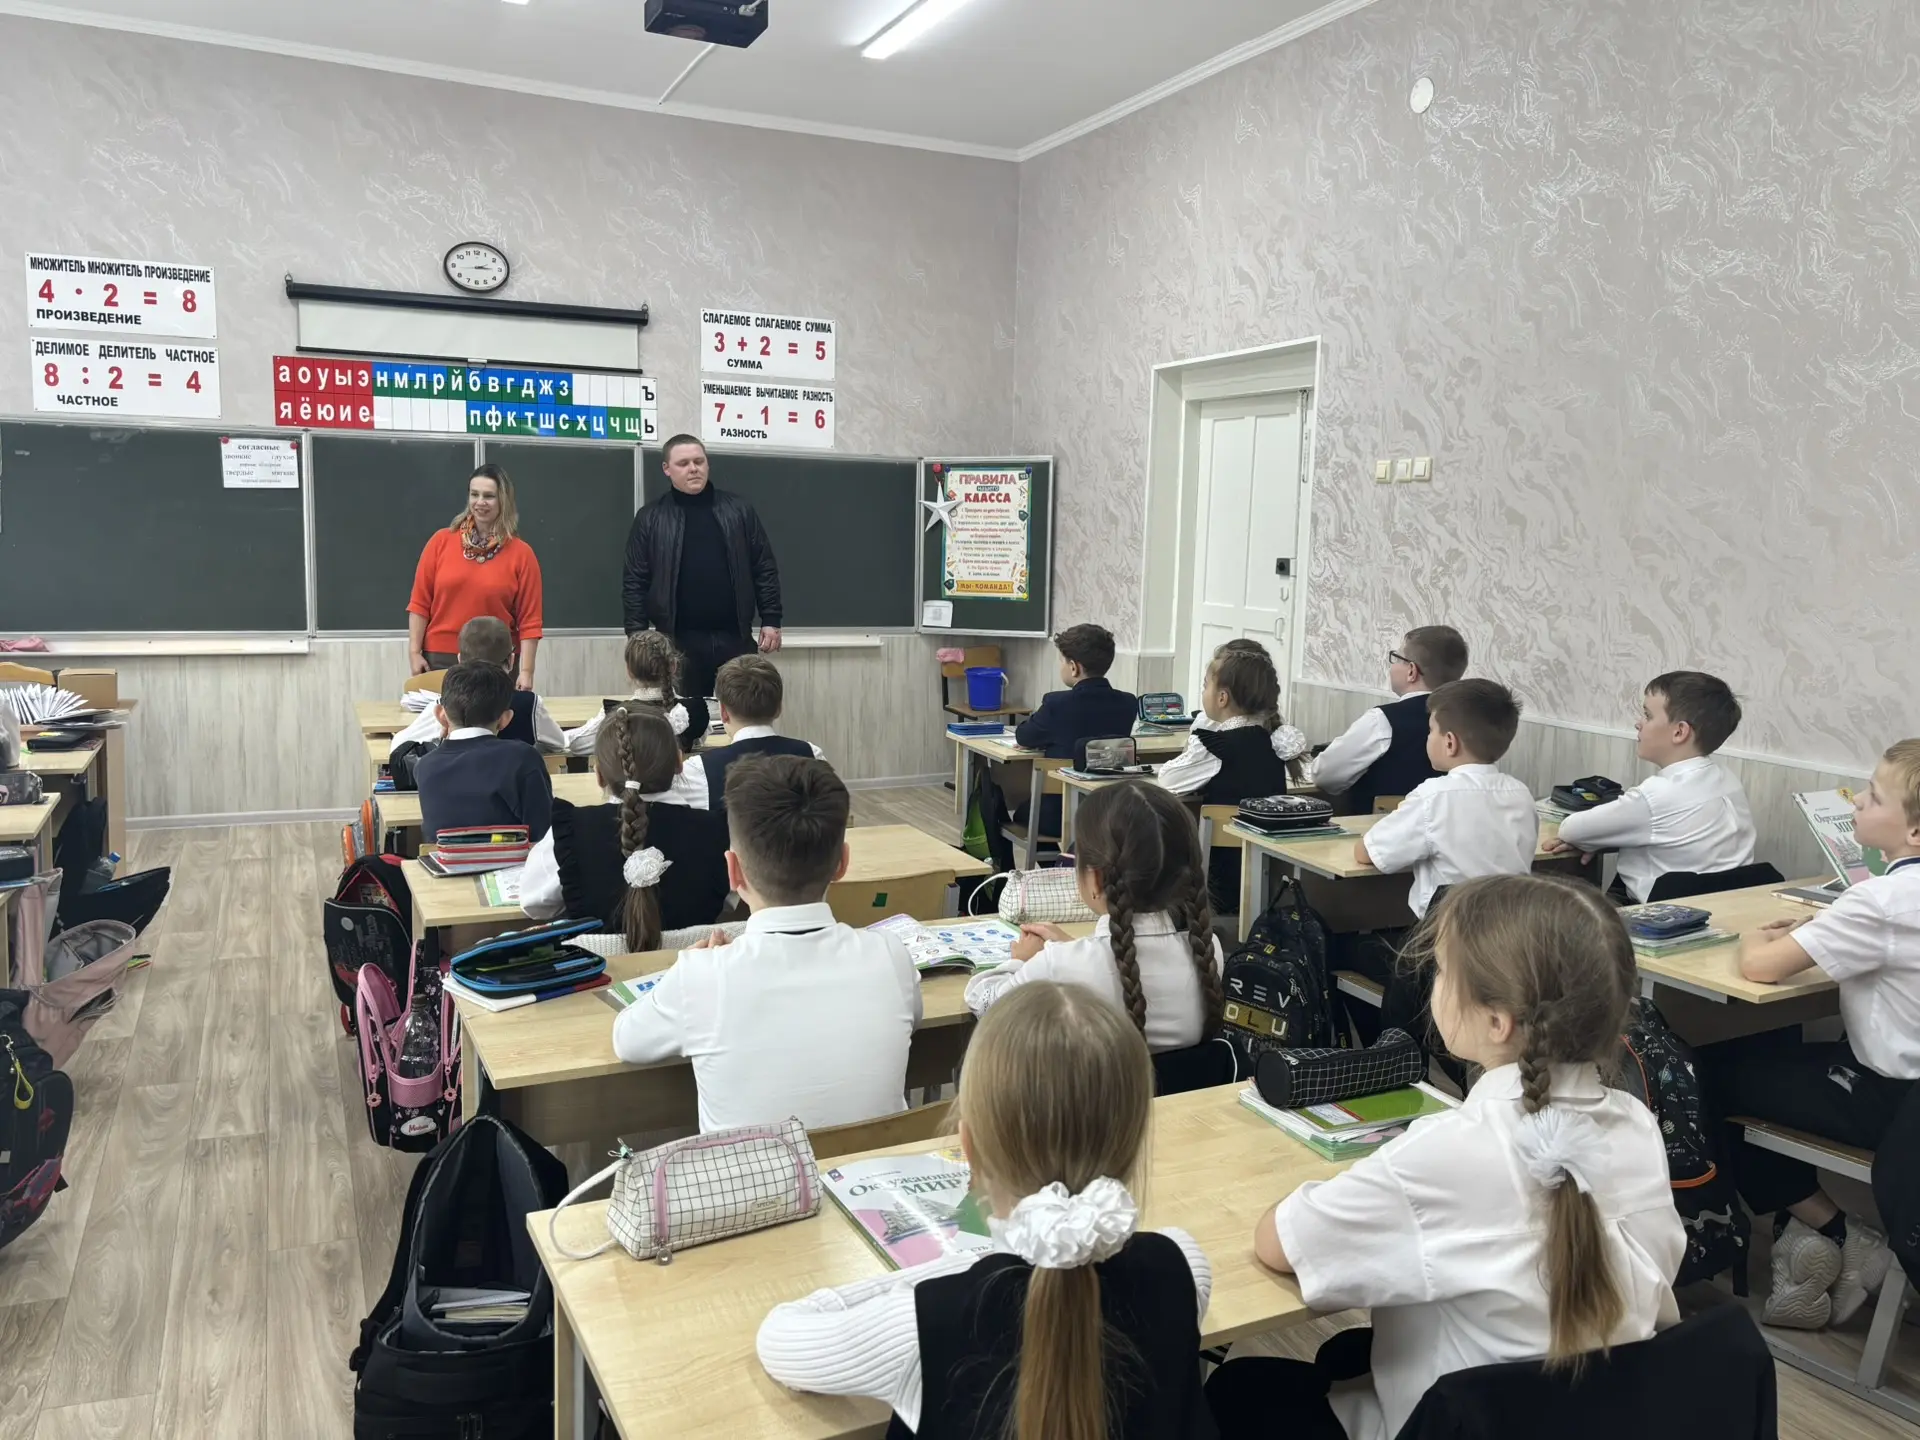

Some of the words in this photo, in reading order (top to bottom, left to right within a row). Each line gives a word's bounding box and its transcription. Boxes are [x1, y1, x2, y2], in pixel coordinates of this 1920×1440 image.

[30, 257, 86, 273] МНОЖИТЕЛЬ
[87, 260, 143, 278] МНОЖИТЕЛЬ
[144, 265, 211, 283] ПРОИЗВЕДЕНИЕ
[38, 279, 55, 303] 4
[103, 283, 119, 307] 2
[144, 291, 157, 305] =
[182, 290, 197, 313] 8
[36, 309, 142, 325] ПРОИЗВЕДЕНИЕ
[703, 312, 751, 327] СЛАГАЕМОЕ
[755, 317, 801, 331] СЛАГАЕМОЕ
[805, 322, 832, 334] СУММА
[35, 341, 90, 356] ДЕЛИМОЕ
[98, 344, 156, 360] ДЕЛИТЕЛЬ
[165, 349, 215, 364] ЧАСТНОЕ
[714, 332, 725, 353] 3
[737, 337, 748, 352] +
[760, 336, 771, 356] 2
[788, 342, 798, 354] =
[815, 340, 826, 361] 5
[727, 359, 763, 370] СУММА
[44, 362, 60, 387] 8
[108, 366, 124, 390] 2
[148, 373, 162, 387] =
[186, 370, 202, 394] 4
[57, 394, 118, 407] ЧАСТНОЕ
[703, 383, 751, 397] УМЕНЬШАЕМОЕ
[756, 387, 798, 400] ВЫЧИТАЕМОЕ
[802, 390, 834, 402] РАЗНОСТЬ
[714, 402, 726, 423] 7
[760, 405, 769, 425] 1
[788, 411, 798, 423] =
[815, 409, 826, 429] 6
[720, 428, 768, 439] РАЗНОСТЬ
[959, 474, 1016, 485] ПРАВИЛА
[964, 493, 1011, 503] КЛАССА
